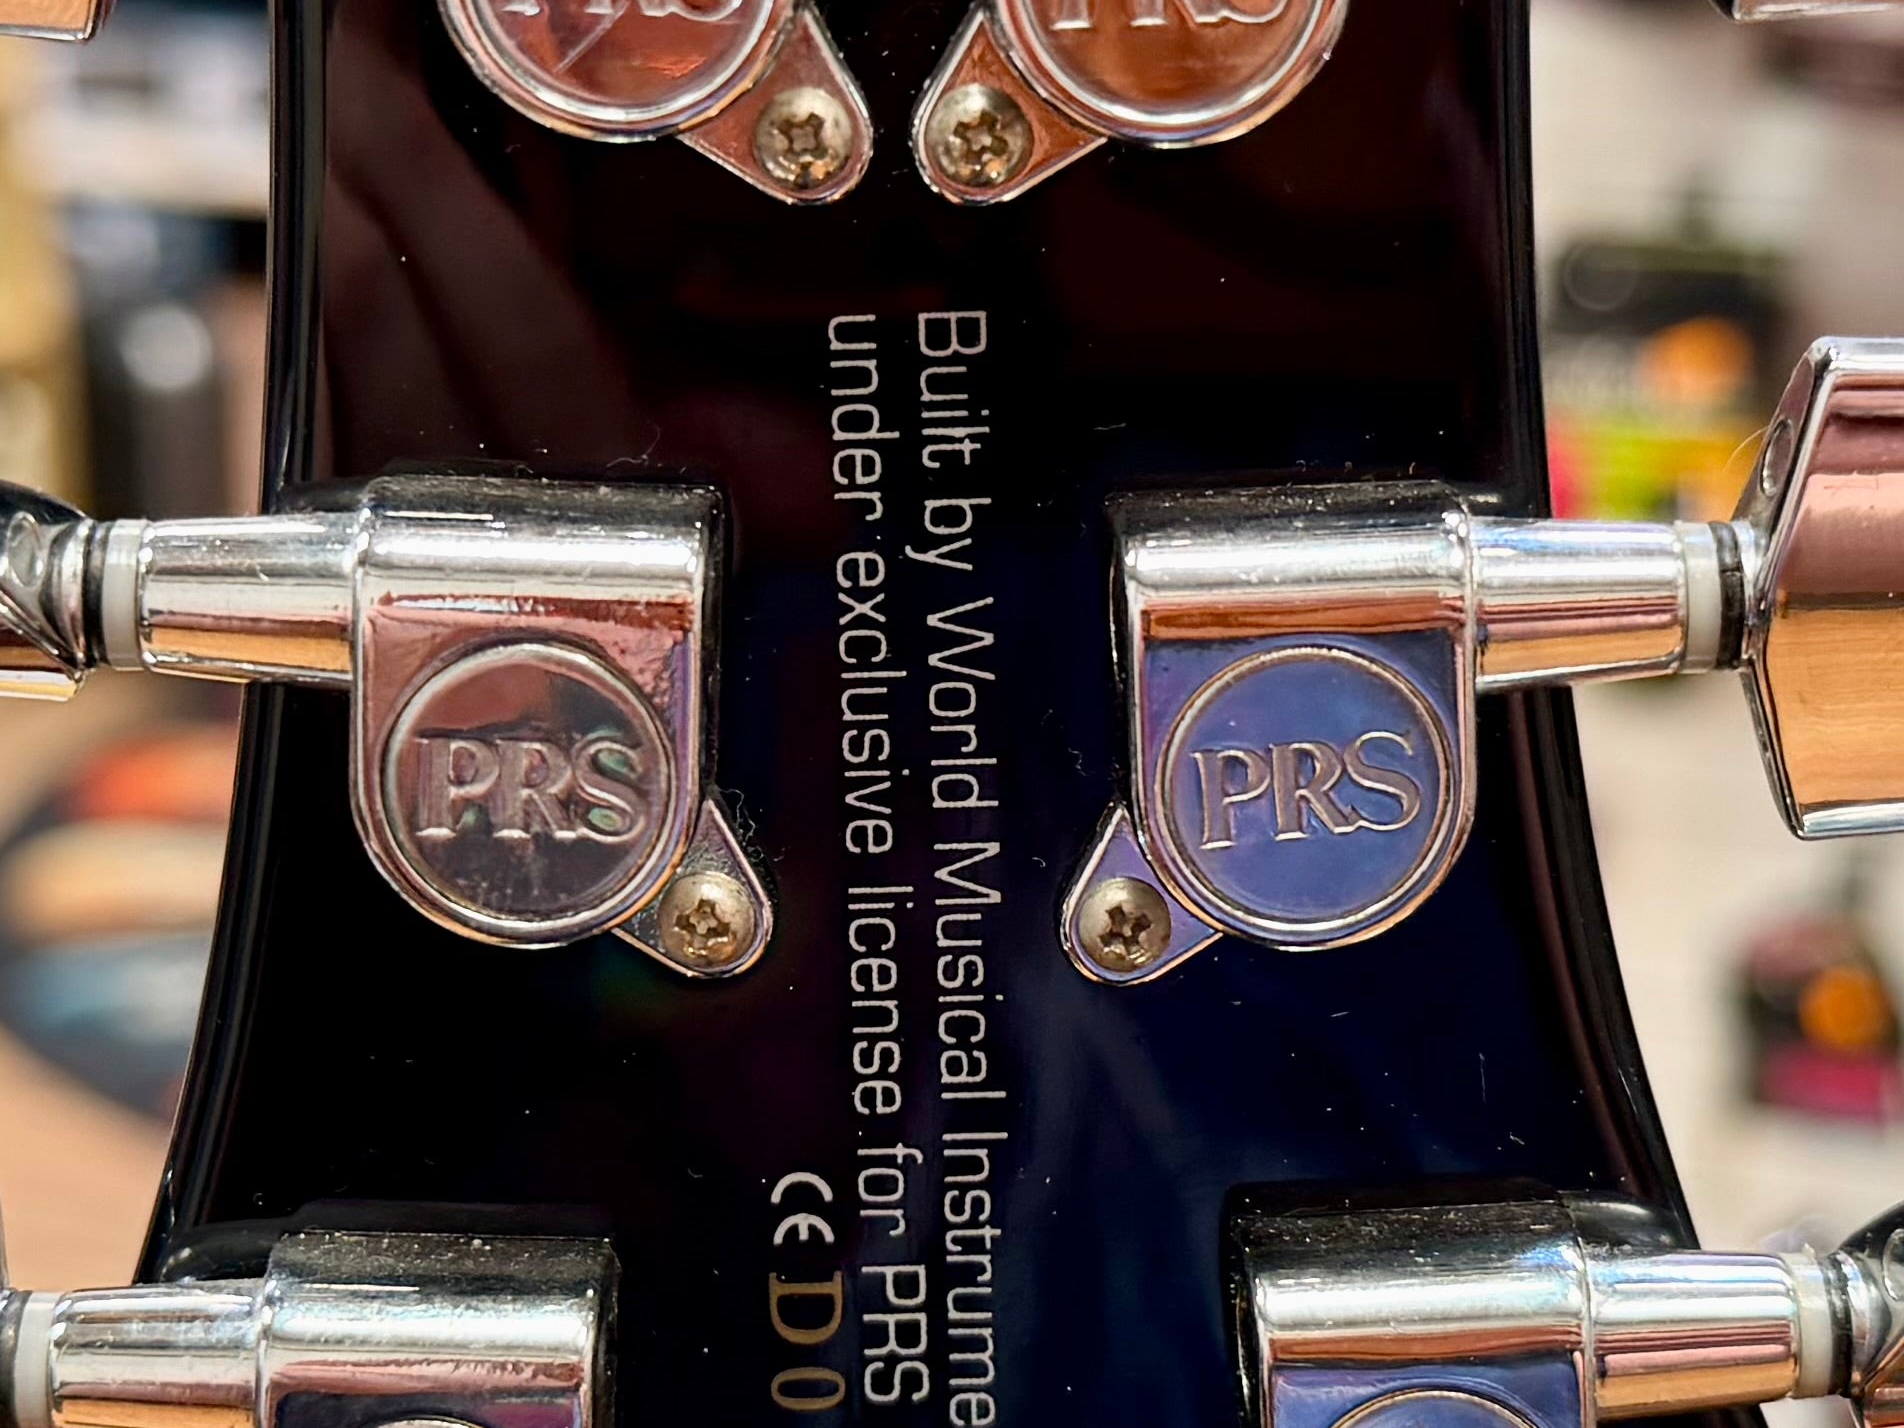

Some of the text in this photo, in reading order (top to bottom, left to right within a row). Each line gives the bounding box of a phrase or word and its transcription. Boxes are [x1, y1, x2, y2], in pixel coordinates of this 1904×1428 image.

[827, 313, 901, 521] under
[917, 309, 992, 469] Built
[904, 497, 994, 571] by
[835, 549, 908, 854] exclusive
[926, 596, 1000, 809] World
[413, 732, 649, 845] PRS
[1192, 729, 1422, 850] PRS
[847, 885, 915, 1116] license
[933, 841, 1006, 1100] Musical
[856, 1142, 925, 1238] for
[860, 1264, 932, 1403] PRS
